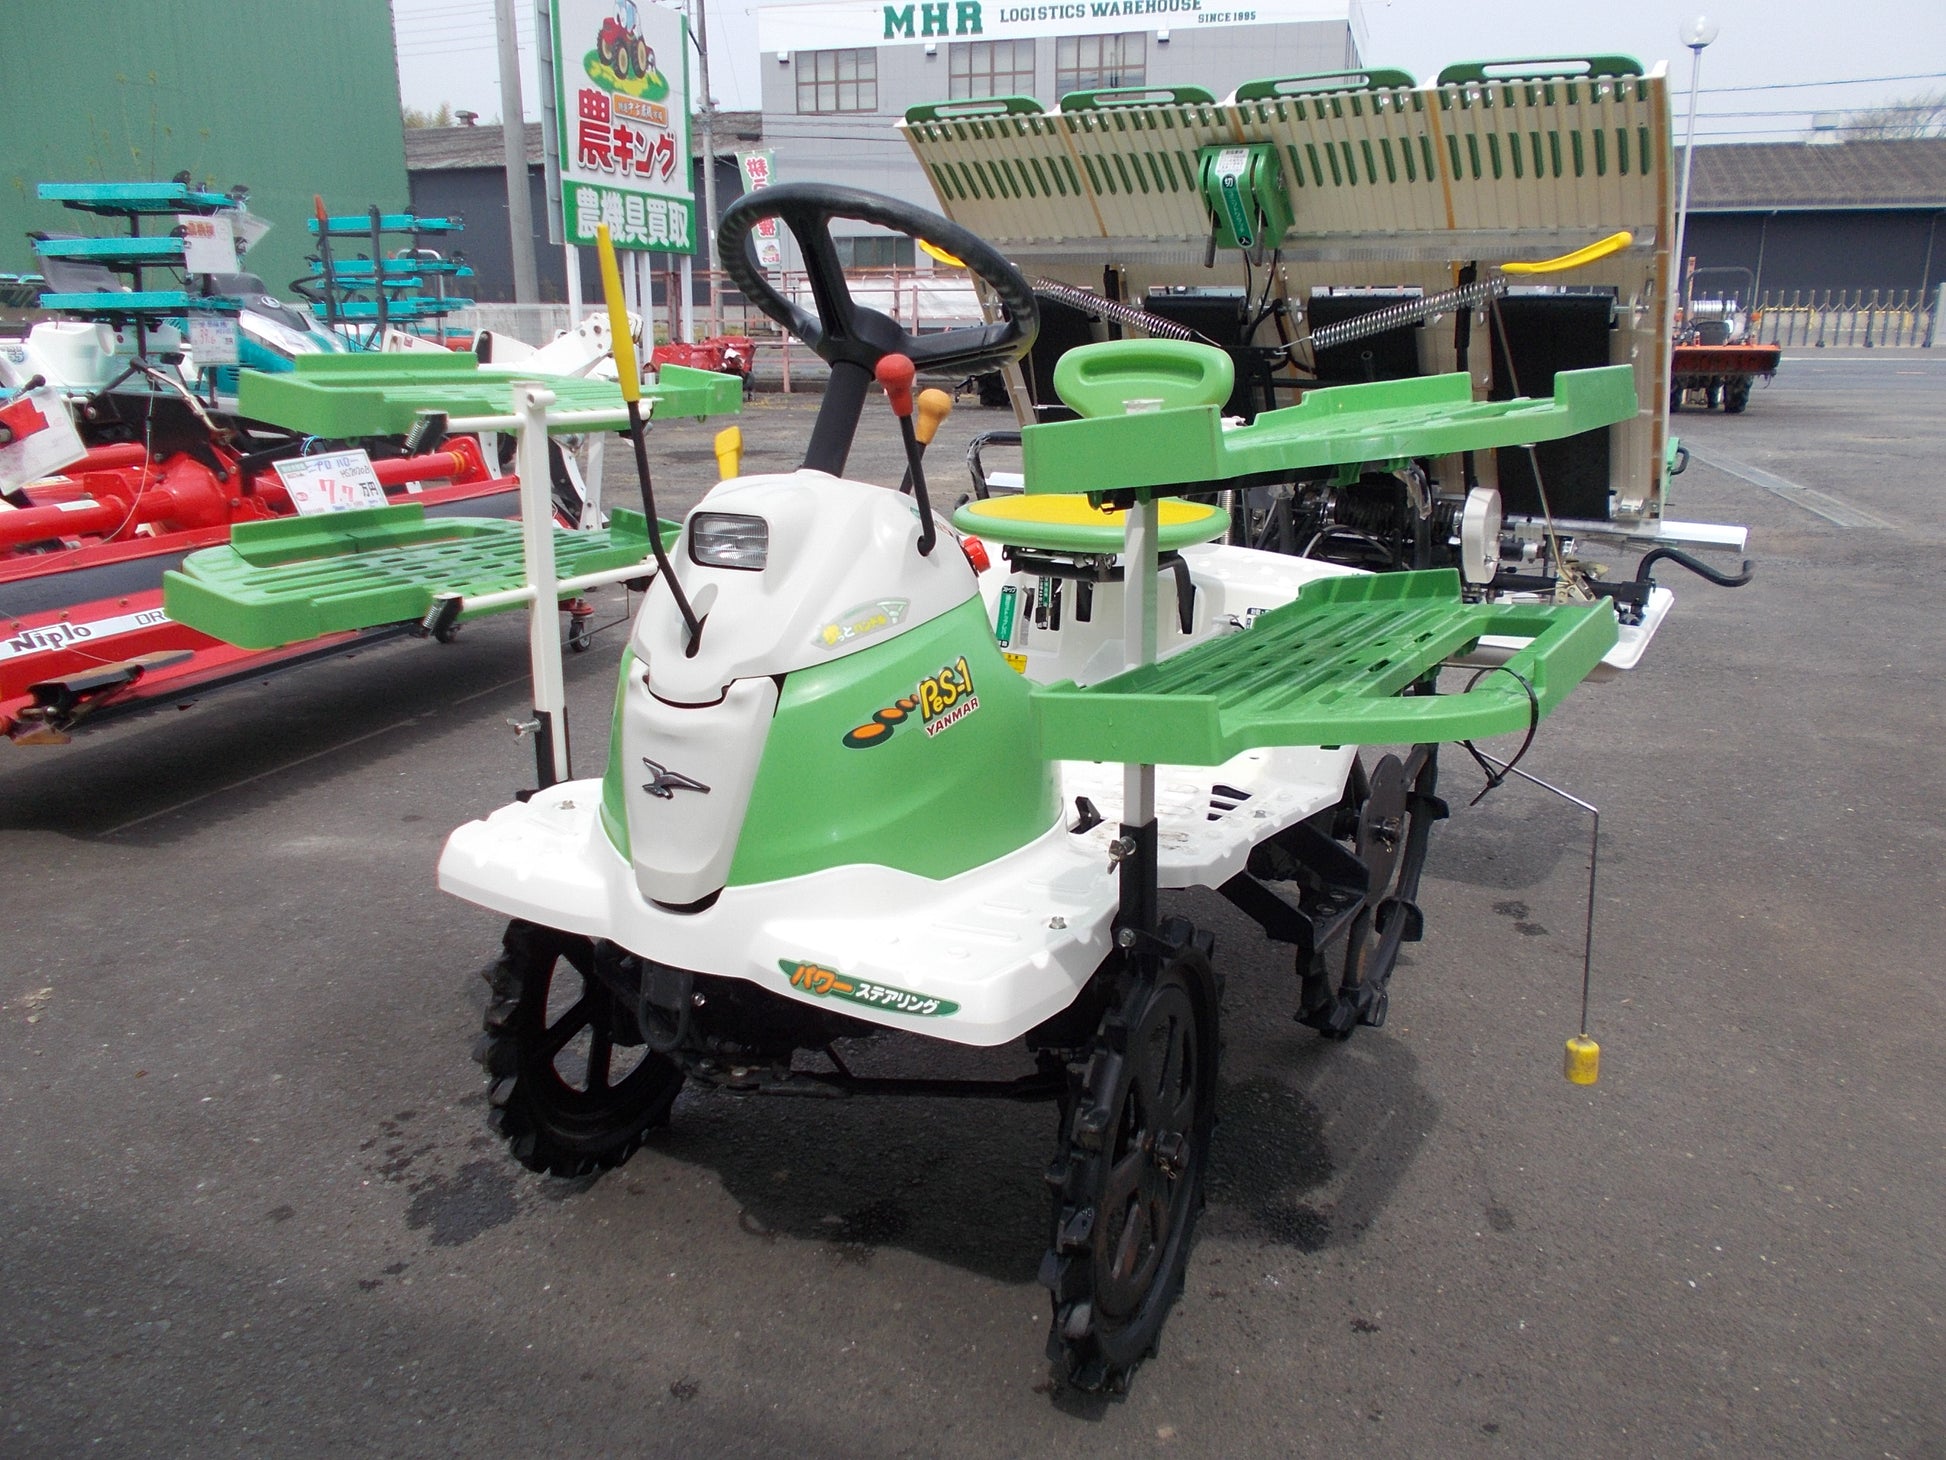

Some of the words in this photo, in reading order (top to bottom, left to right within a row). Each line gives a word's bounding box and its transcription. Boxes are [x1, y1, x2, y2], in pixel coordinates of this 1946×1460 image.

[884, 1, 983, 39] MHR
[1000, 4, 1085, 23] LOGISTICS
[1091, 0, 1202, 17] WAREHOUSE
[1198, 13, 1231, 23] SINCE
[578, 88, 676, 179] 農キング
[577, 187, 690, 248] 農機具買取
[9, 624, 91, 653] Niplo
[919, 656, 975, 724] PeS-1
[926, 697, 979, 737] YANMAR
